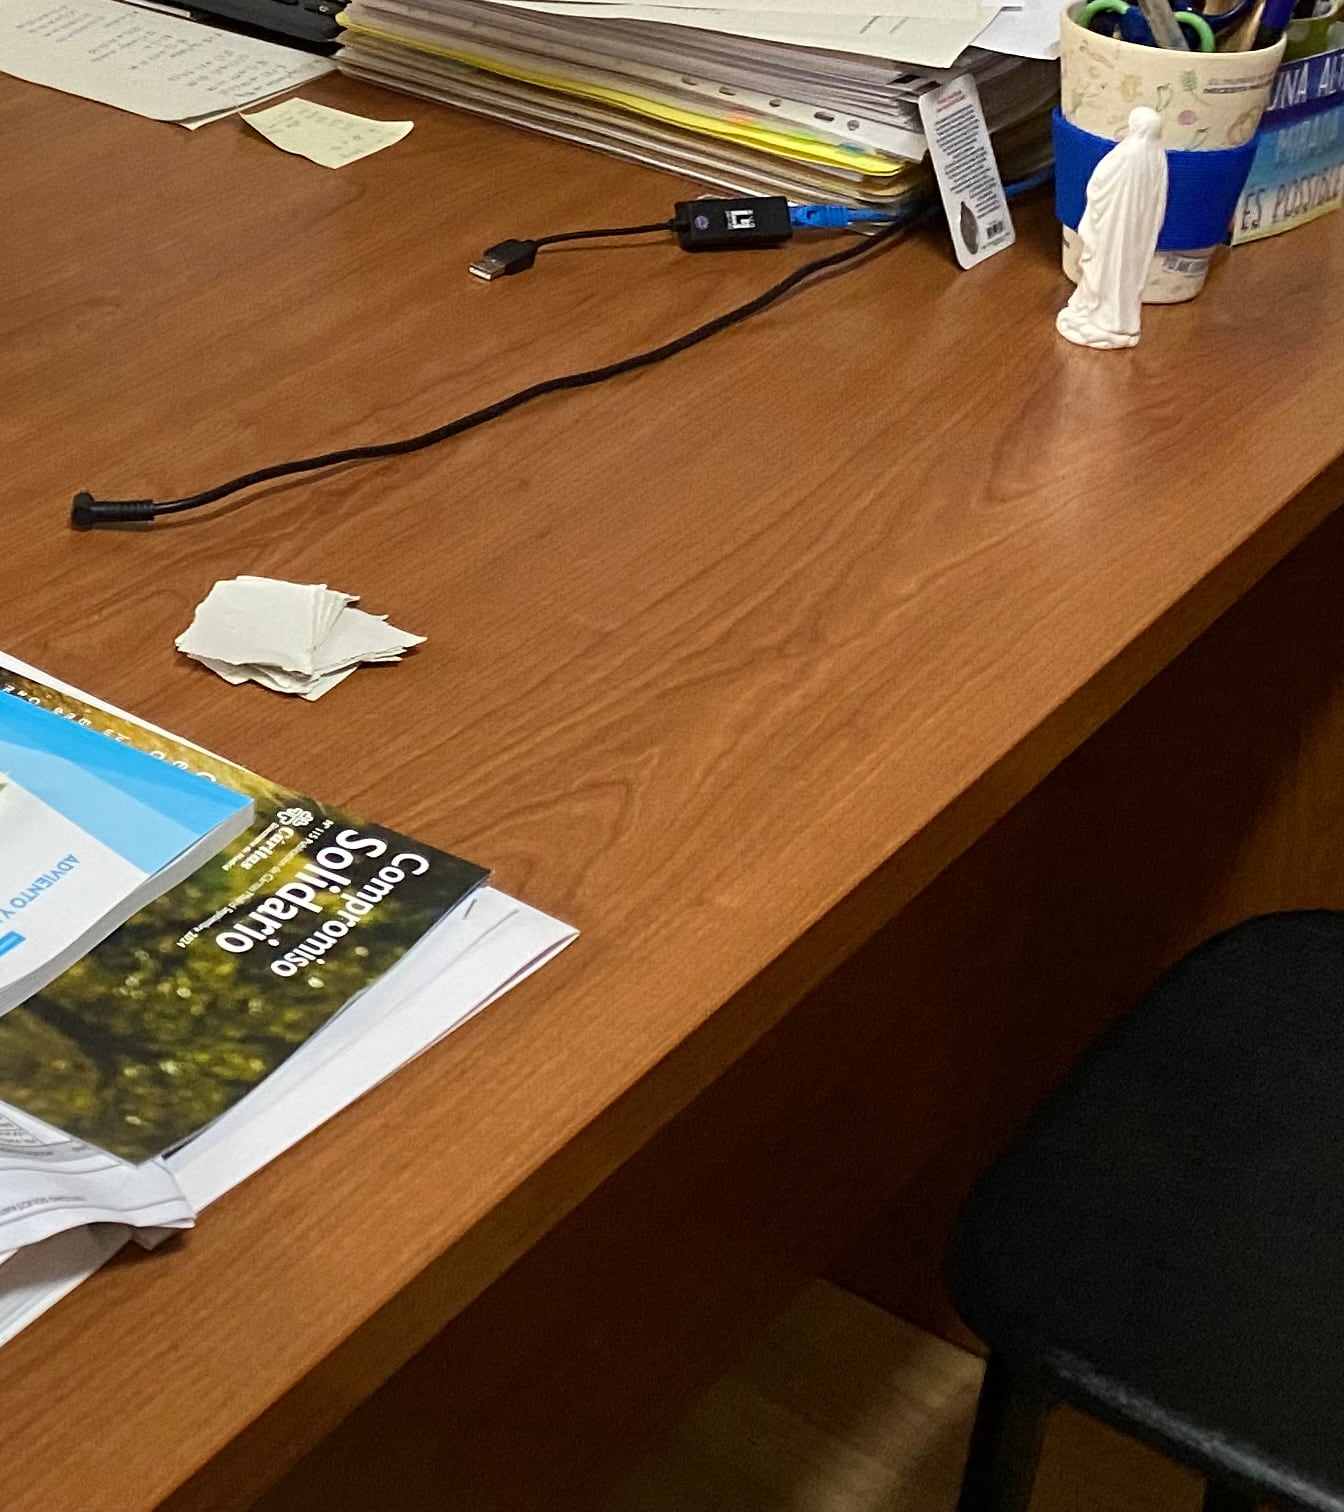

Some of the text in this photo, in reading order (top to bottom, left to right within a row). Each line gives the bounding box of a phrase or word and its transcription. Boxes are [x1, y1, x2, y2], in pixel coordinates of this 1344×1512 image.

[239, 824, 294, 871] Cáritas
[306, 826, 323, 839] 115
[9, 853, 78, 911] ADVIENTO
[216, 829, 387, 953] Solidario
[175, 928, 198, 949] 2024
[270, 853, 429, 977] Compromiso
